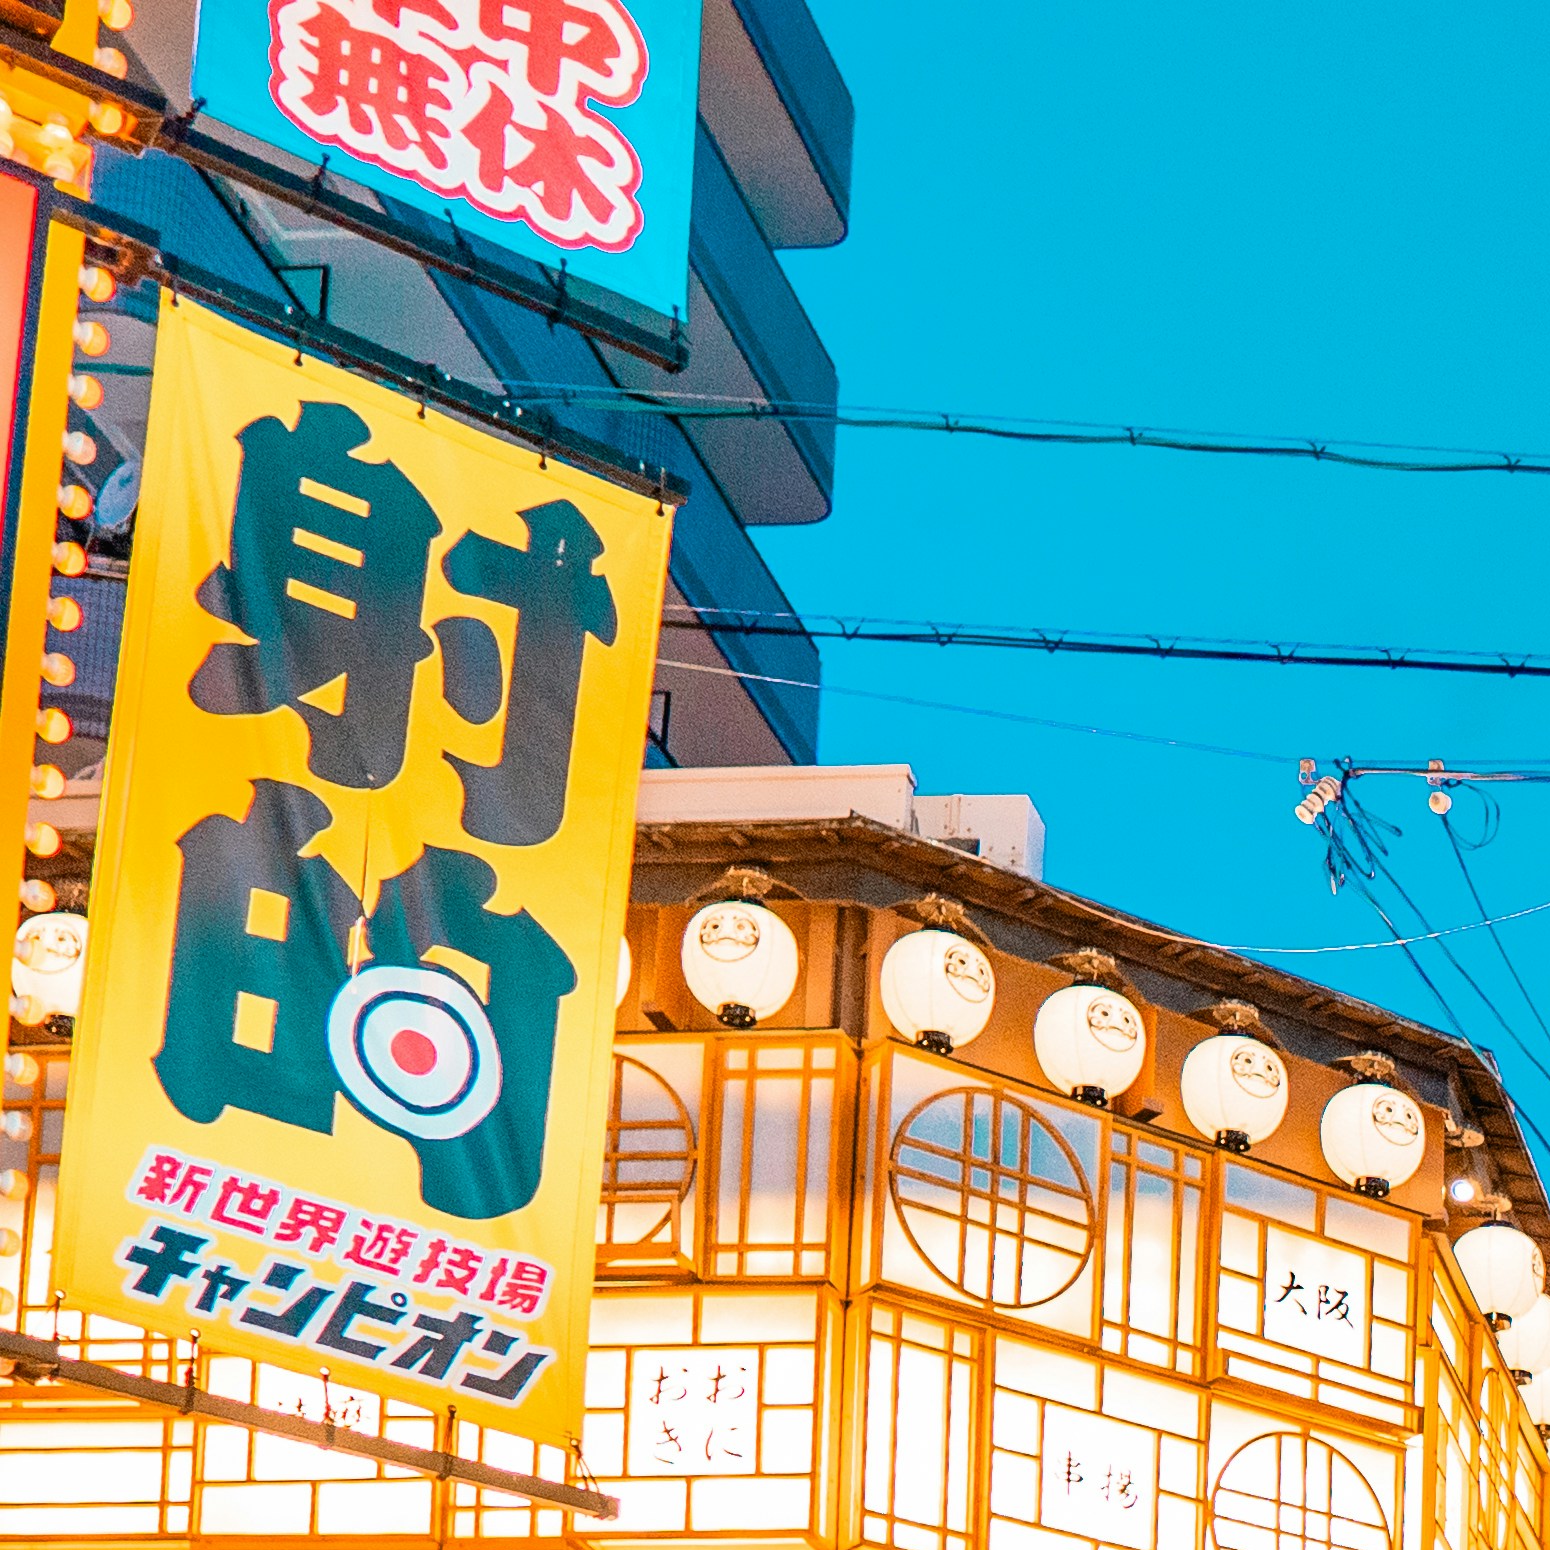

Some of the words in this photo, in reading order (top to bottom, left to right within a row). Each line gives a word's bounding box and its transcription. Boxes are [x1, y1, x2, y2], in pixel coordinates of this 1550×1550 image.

[298, 2, 617, 224] 無休
[370, 0, 621, 96] 中
[151, 402, 618, 1219] 射的
[126, 1227, 549, 1402] チャンピオン
[137, 1152, 551, 1315] 新世界遊技場
[1274, 1269, 1357, 1331] 大阪
